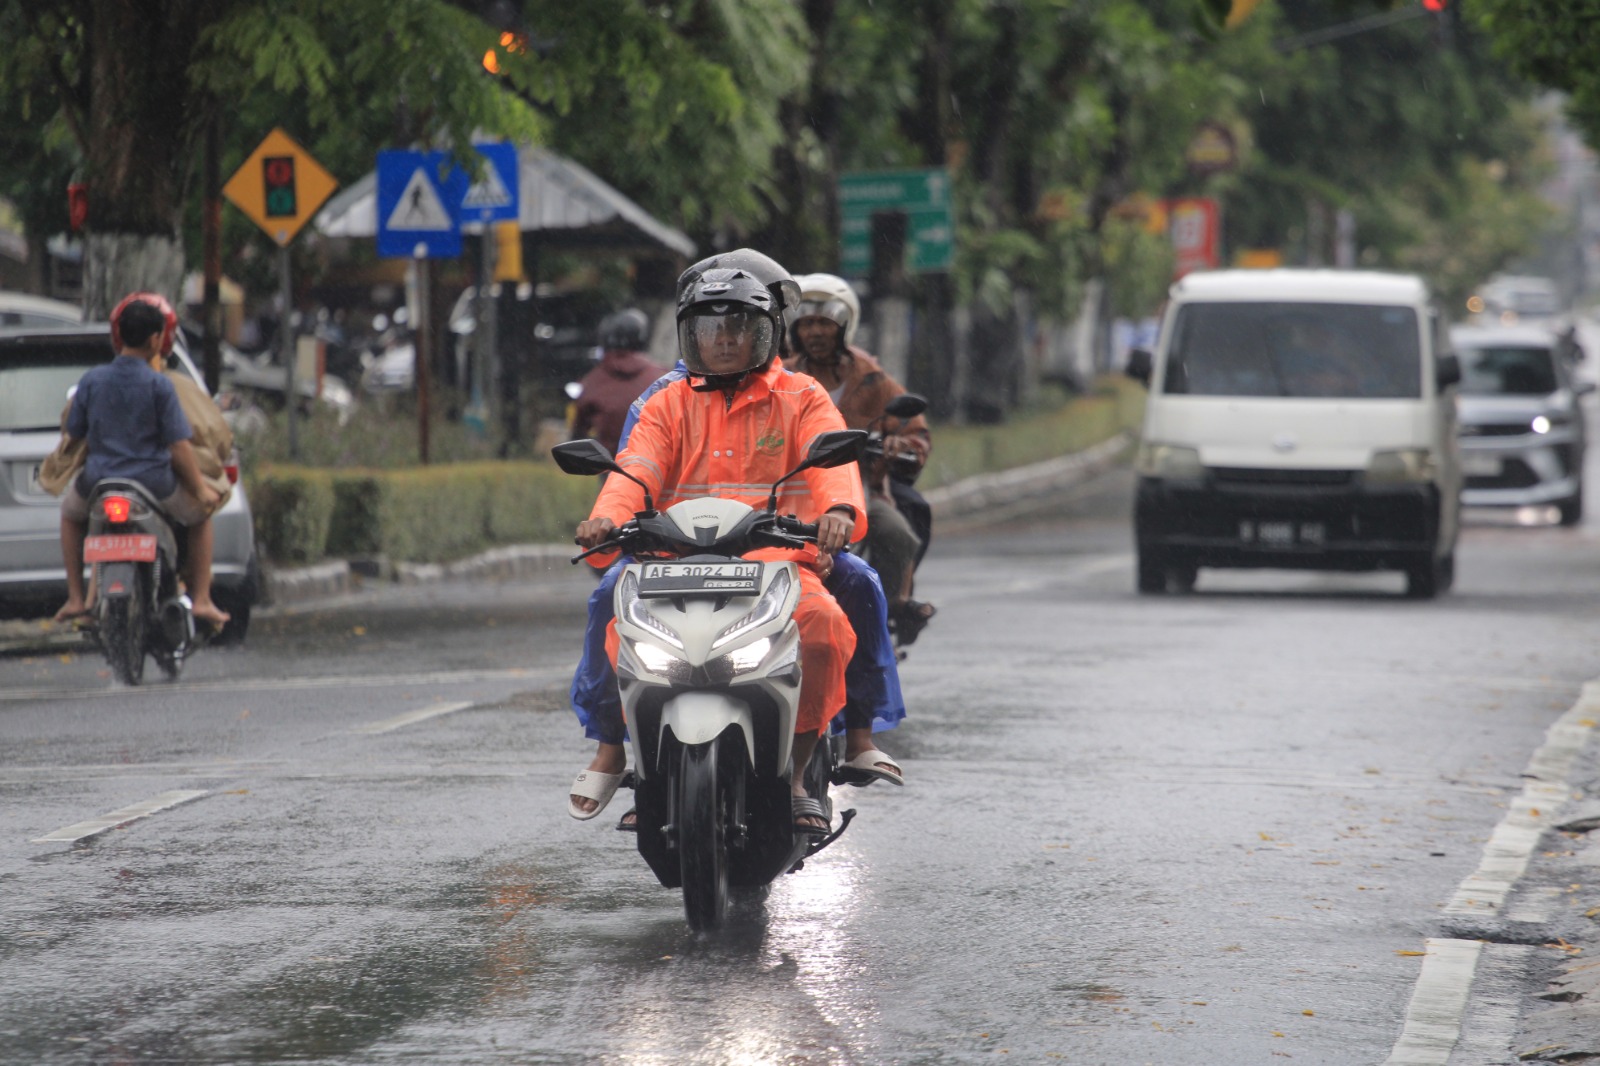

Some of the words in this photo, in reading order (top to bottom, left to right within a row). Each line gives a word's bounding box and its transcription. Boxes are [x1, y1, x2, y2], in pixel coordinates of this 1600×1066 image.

[650, 566, 672, 577] AE
[682, 566, 724, 577] 3024
[734, 566, 757, 577] DW
